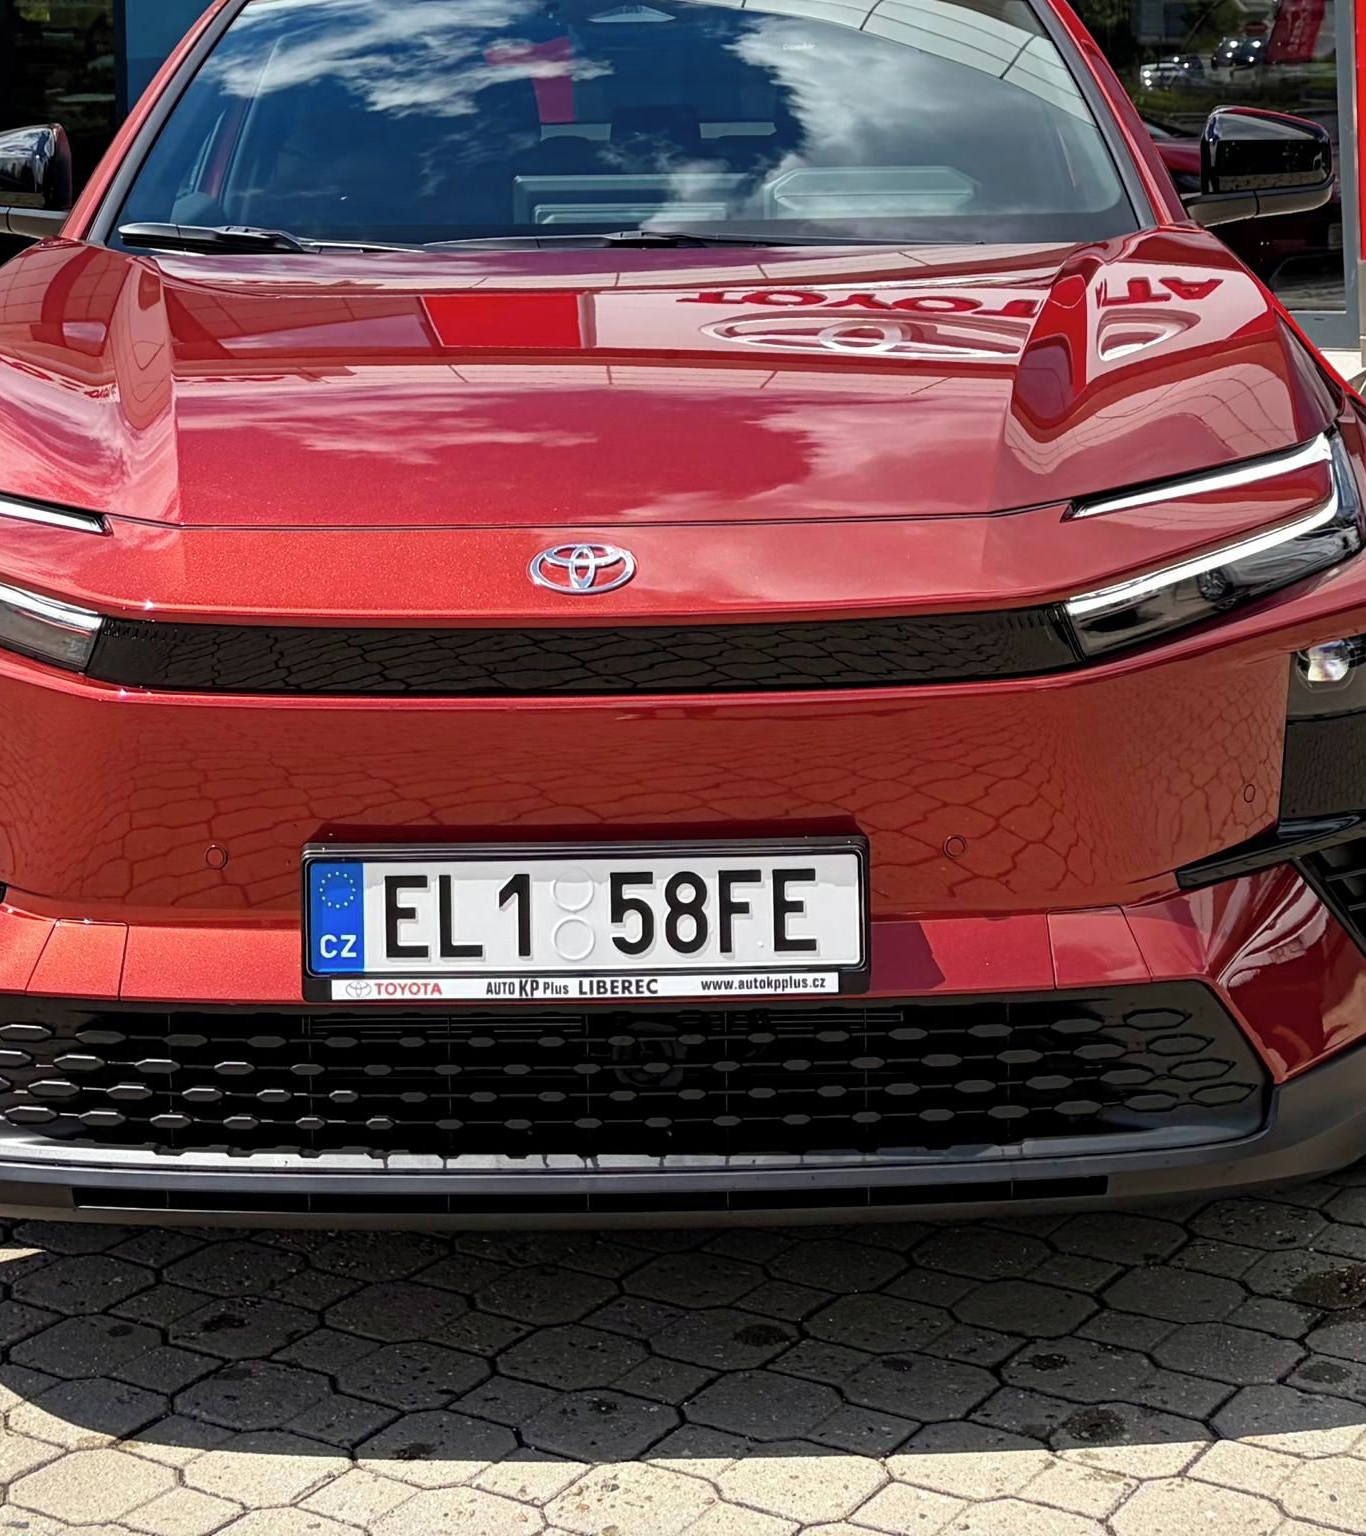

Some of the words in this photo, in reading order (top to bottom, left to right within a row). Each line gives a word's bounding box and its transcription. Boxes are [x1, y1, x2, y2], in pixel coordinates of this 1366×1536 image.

[384, 873, 531, 960] EL1
[609, 867, 817, 957] 58FE
[319, 934, 357, 959] CZ
[375, 982, 443, 996] TOYOTA
[486, 982, 516, 996] AUTO
[519, 979, 540, 997] KP
[543, 981, 569, 995] Plus
[579, 978, 659, 996] LIBEREC
[701, 975, 827, 992] www.autokpplus.cz
